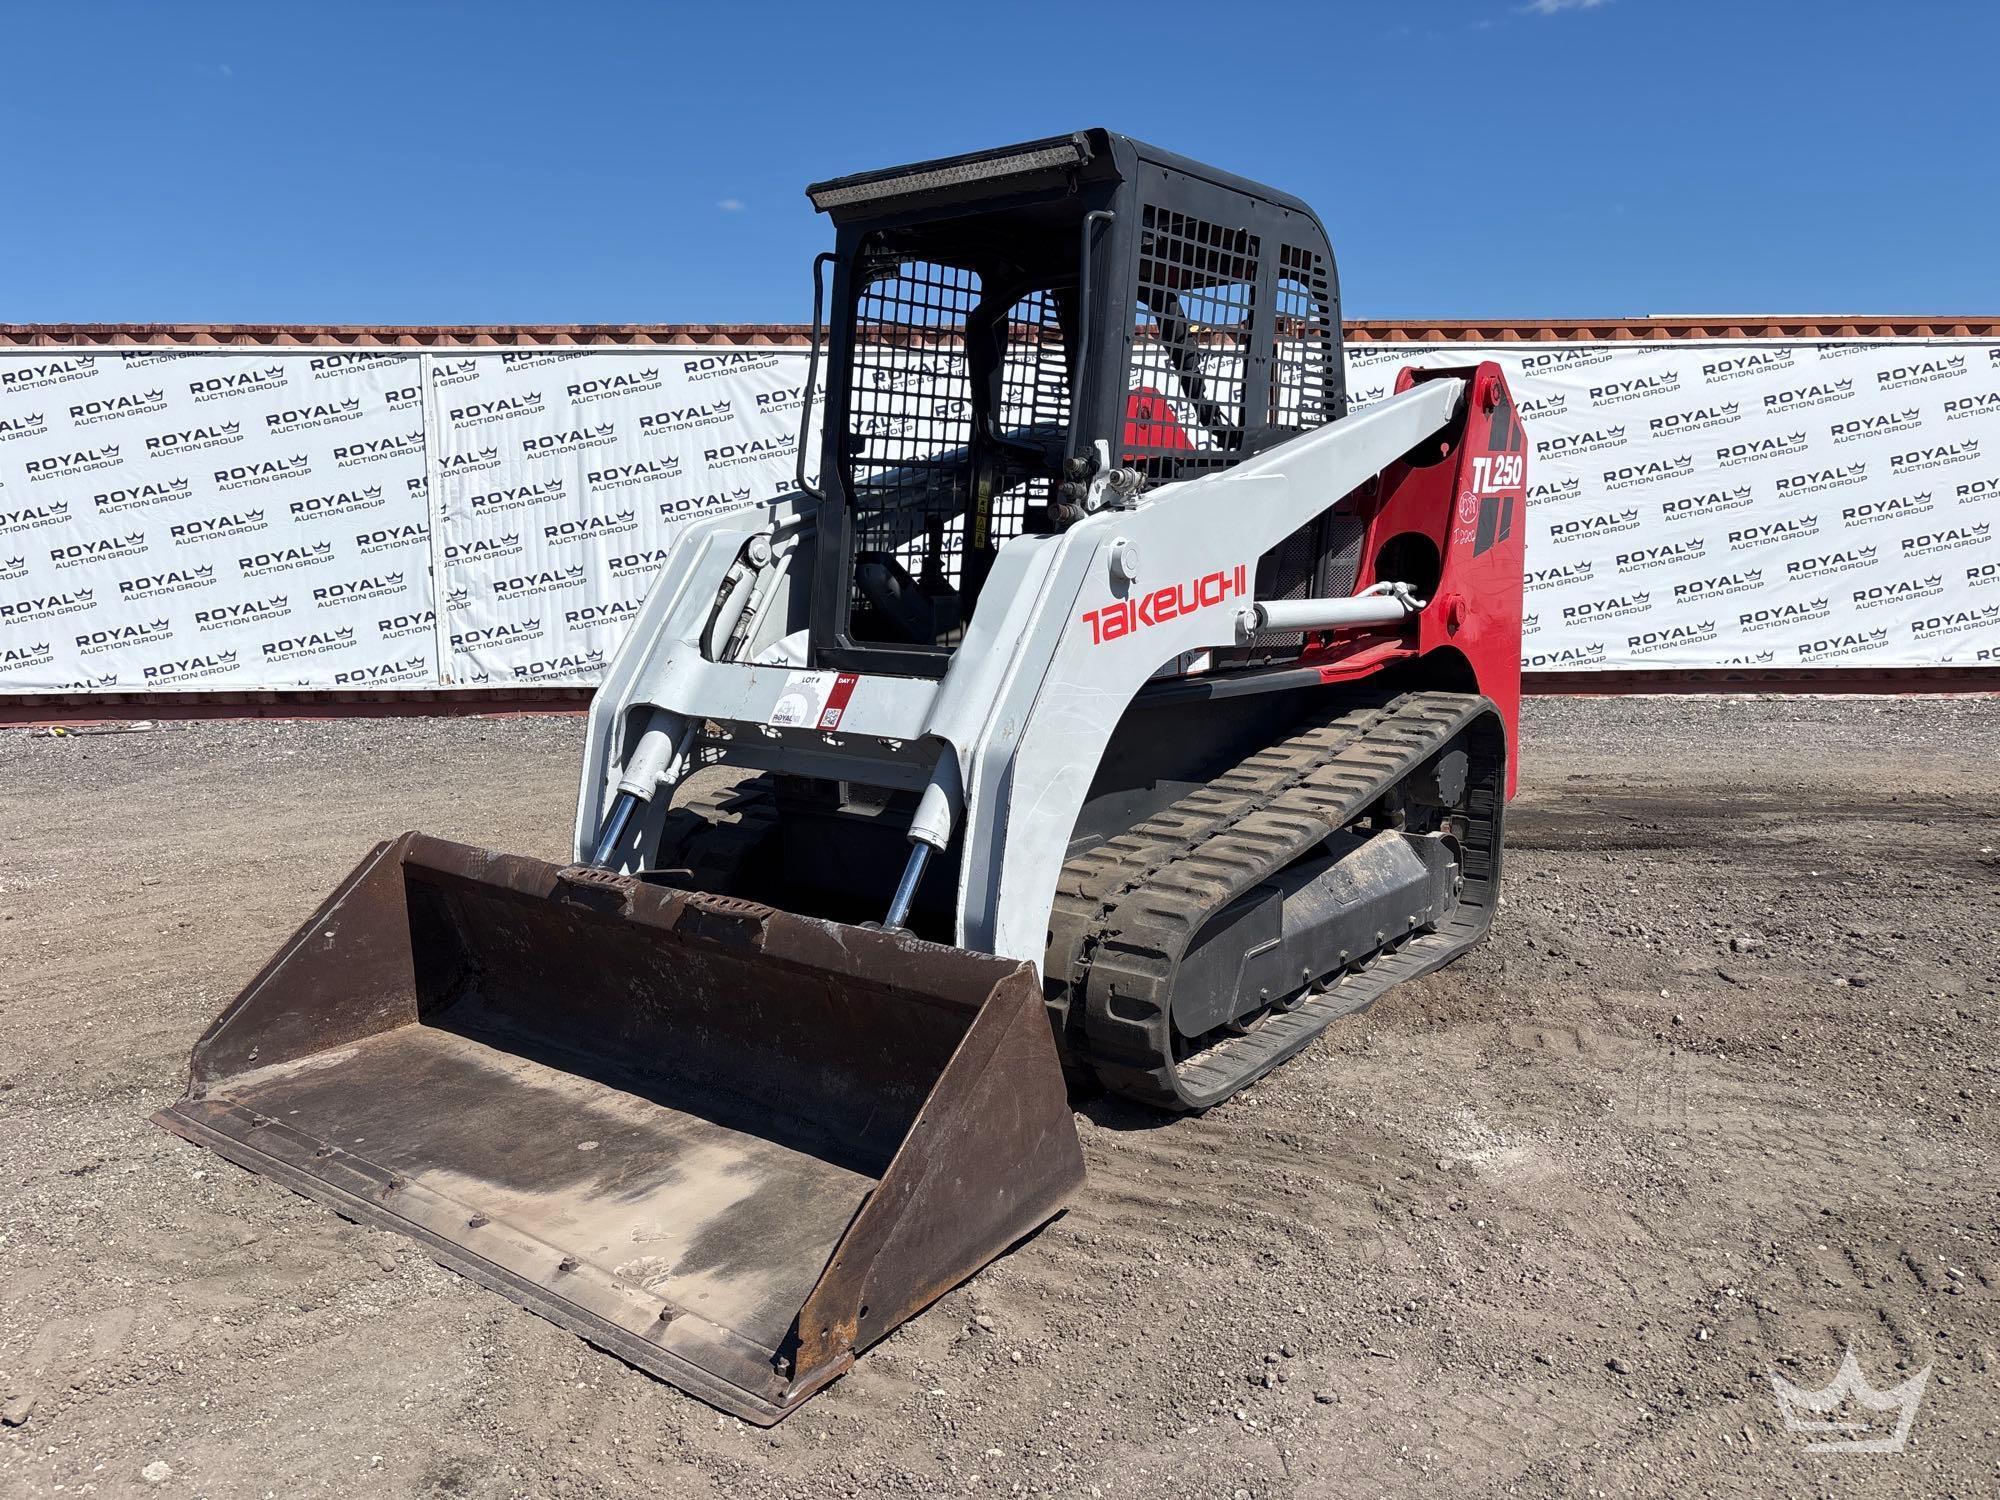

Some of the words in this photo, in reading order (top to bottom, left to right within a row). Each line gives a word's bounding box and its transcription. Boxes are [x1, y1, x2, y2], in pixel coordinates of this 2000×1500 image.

[1, 361, 77, 385] ROYAL
[1702, 353, 1774, 376] ROYAL
[1706, 369, 1754, 384] AUCTION
[1756, 361, 1795, 374] GROUP
[1877, 361, 1948, 383] ROYAL
[6, 378, 57, 394] AUCTION
[58, 369, 99, 383] GROUP
[189, 371, 266, 395] ROYAL
[194, 388, 246, 403] AUCTION
[247, 379, 288, 393] GROUP
[566, 373, 641, 397] ROYAL
[1589, 377, 1660, 399] ROYAL
[1880, 376, 1928, 391] AUCTION
[1930, 368, 1967, 381] GROUP
[571, 390, 621, 406] AUCTION
[622, 382, 662, 395] GROUP
[1592, 392, 1641, 407] AUCTION
[1642, 384, 1681, 397] GROUP
[1763, 384, 1835, 407] ROYAL
[1766, 400, 1815, 415] AUCTION
[1817, 391, 1855, 404] GROUP
[69, 394, 145, 418] ROYAL
[74, 411, 125, 427] AUCTION
[127, 403, 168, 416] GROUP
[265, 403, 341, 427] ROYAL
[449, 397, 524, 421] ROYAL
[454, 414, 504, 430] AUCTION
[505, 405, 545, 419] GROUP
[639, 405, 713, 428] ROYAL
[270, 420, 321, 435] AUCTION
[323, 411, 363, 425] GROUP
[643, 422, 693, 437] AUCTION
[694, 414, 734, 427] GROUP
[1649, 407, 1721, 430] ROYAL
[1652, 423, 1701, 439] AUCTION
[1703, 415, 1741, 428] GROUP
[1830, 413, 1902, 436] ROYAL
[145, 426, 222, 450] ROYAL
[522, 428, 596, 452] ROYAL
[1537, 431, 1607, 453] ROYAL
[1833, 429, 1882, 444] AUCTION
[1884, 421, 1922, 434] GROUP
[150, 443, 201, 459] AUCTION
[203, 435, 244, 448] GROUP
[527, 445, 577, 460] AUCTION
[578, 436, 618, 450] GROUP
[1540, 446, 1587, 462] AUCTION
[1589, 438, 1627, 451] GROUP
[1716, 437, 1788, 460] ROYAL
[1719, 453, 1768, 468] AUCTION
[1770, 444, 1808, 457] GROUP
[1890, 444, 1961, 467] ROYAL
[25, 450, 102, 474] ROYAL
[30, 467, 81, 482] AUCTION
[83, 458, 124, 472] GROUP
[587, 461, 661, 484] ROYAL
[1603, 460, 1674, 483] ROYAL
[1893, 460, 1941, 475] AUCTION
[1943, 452, 1981, 465] GROUP
[591, 477, 641, 493] AUCTION
[643, 469, 682, 482] GROUP
[1472, 455, 1523, 494] TL250
[1606, 476, 1654, 491] AUCTION
[1656, 468, 1694, 481] GROUP
[94, 483, 170, 506] ROYAL
[99, 499, 150, 515] AUCTION
[151, 491, 192, 504] GROUP
[289, 491, 364, 514] ROYAL
[471, 484, 545, 508] ROYAL
[475, 501, 525, 516] AUCTION
[527, 492, 566, 506] GROUP
[659, 493, 733, 515] ROYAL
[1662, 491, 1733, 514] ROYAL
[294, 507, 344, 523] AUCTION
[346, 499, 385, 512] GROUP
[664, 509, 713, 524] AUCTION
[714, 501, 754, 514] GROUP
[1665, 507, 1713, 522] AUCTION
[1715, 499, 1753, 512] GROUP
[170, 514, 246, 538] ROYAL
[175, 531, 226, 546] AUCTION
[228, 522, 268, 536] GROUP
[544, 515, 617, 538] ROYAL
[548, 531, 597, 547] AUCTION
[599, 523, 638, 536] GROUP
[1550, 514, 1621, 537] ROYAL
[1553, 530, 1601, 544] AUCTION
[1602, 522, 1640, 534] GROUP
[1728, 520, 1799, 543] ROYAL
[1731, 536, 1779, 551] AUCTION
[1781, 528, 1819, 541] GROUP
[1901, 528, 1972, 550] ROYAL
[1903, 543, 1952, 558] AUCTION
[1954, 535, 1992, 548] GROUP
[238, 547, 313, 570] ROYAL
[243, 563, 294, 579] AUCTION
[295, 555, 335, 568] GROUP
[1787, 551, 1858, 574] ROYAL
[1789, 567, 1838, 582] AUCTION
[1840, 558, 1879, 571] GROUP
[118, 570, 195, 593] ROYAL
[124, 586, 175, 602] AUCTION
[176, 578, 217, 591] GROUP
[313, 577, 386, 600] ROYAL
[492, 570, 566, 593] ROYAL
[497, 586, 547, 602] AUCTION
[548, 578, 587, 591] GROUP
[1853, 580, 1924, 602] ROYAL
[0, 594, 75, 618] ROYAL
[317, 593, 367, 609] AUCTION
[368, 585, 407, 598] GROUP
[1562, 597, 1632, 619] ROYAL
[1855, 595, 1904, 611] AUCTION
[1905, 587, 1944, 600] GROUP
[5, 610, 55, 626] AUCTION
[56, 602, 97, 615] GROUP
[195, 600, 270, 624] ROYAL
[199, 617, 250, 632] AUCTION
[252, 608, 292, 622] GROUP
[1565, 612, 1613, 627] AUCTION
[1614, 604, 1652, 617] GROUP
[1739, 603, 1810, 625] ROYAL
[1742, 618, 1790, 633] AUCTION
[1792, 610, 1830, 623] GROUP
[1911, 610, 1982, 633] ROYAL
[75, 624, 151, 647] ROYAL
[1628, 625, 1697, 648] ROYAL
[1914, 626, 1961, 640] AUCTION
[1963, 618, 2000, 630] GROUP
[80, 640, 131, 656] AUCTION
[133, 632, 173, 645] GROUP
[262, 632, 336, 655] ROYAL
[266, 648, 316, 663] AUCTION
[318, 640, 357, 653] GROUP
[1631, 641, 1678, 655] AUCTION
[1679, 633, 1717, 646] GROUP
[1798, 633, 1869, 655] ROYAL
[1801, 649, 1849, 663] AUCTION
[1851, 640, 1889, 653] GROUP
[143, 656, 219, 679] ROYAL
[148, 672, 198, 687] AUCTION
[200, 663, 240, 677] GROUP
[772, 714, 793, 722] ROYAL
